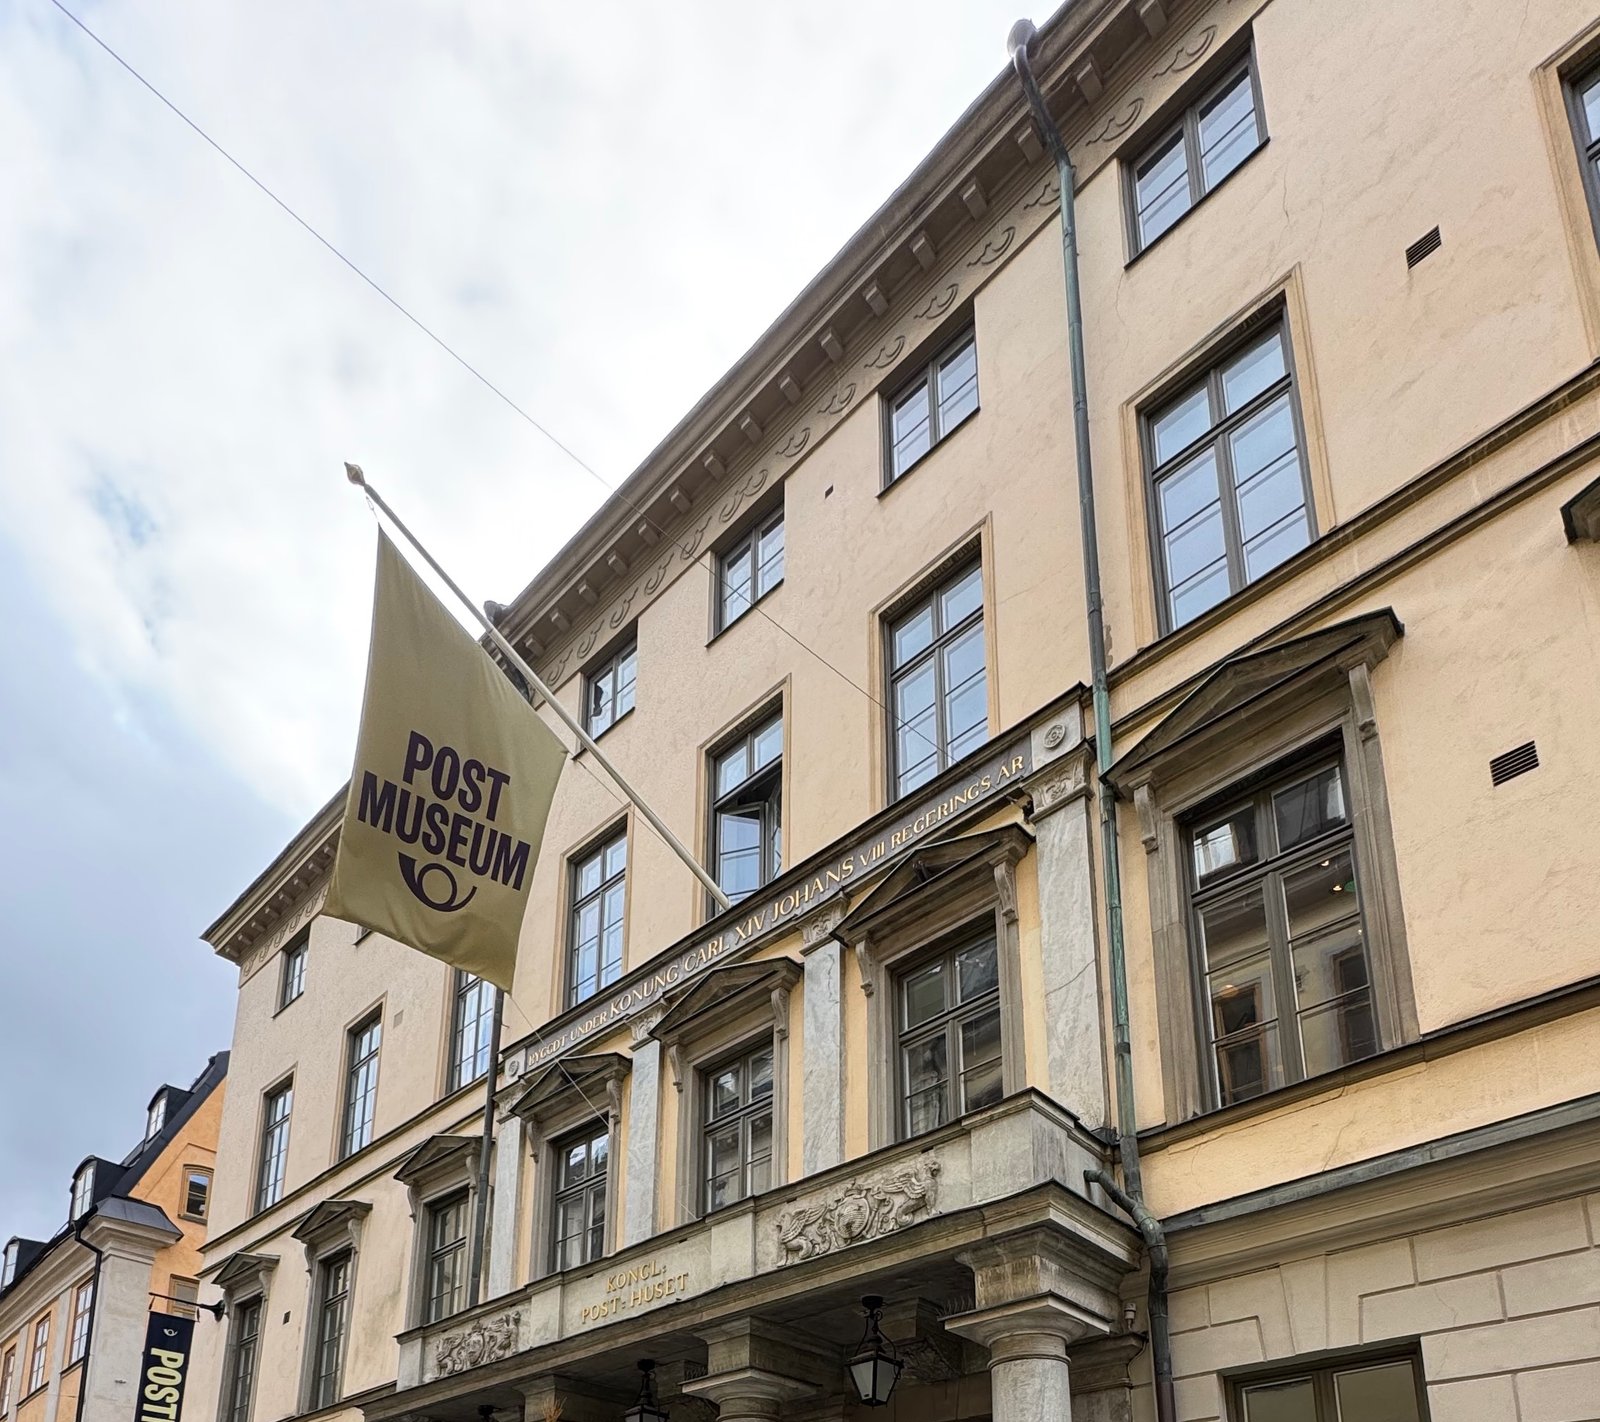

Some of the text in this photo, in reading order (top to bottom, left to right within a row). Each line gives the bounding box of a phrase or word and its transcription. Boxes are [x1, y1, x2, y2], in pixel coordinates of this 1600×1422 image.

[403, 730, 511, 823] POST
[358, 770, 531, 892] MUSEUM
[570, 1010, 607, 1041] UNDER
[609, 964, 679, 1019] KONUNG
[684, 935, 730, 972] CARL
[735, 909, 766, 945] XIV
[771, 856, 854, 922] JOHANS
[860, 841, 885, 867] VIII
[891, 775, 991, 850] REGERINGS
[630, 1272, 689, 1308] HUSET
